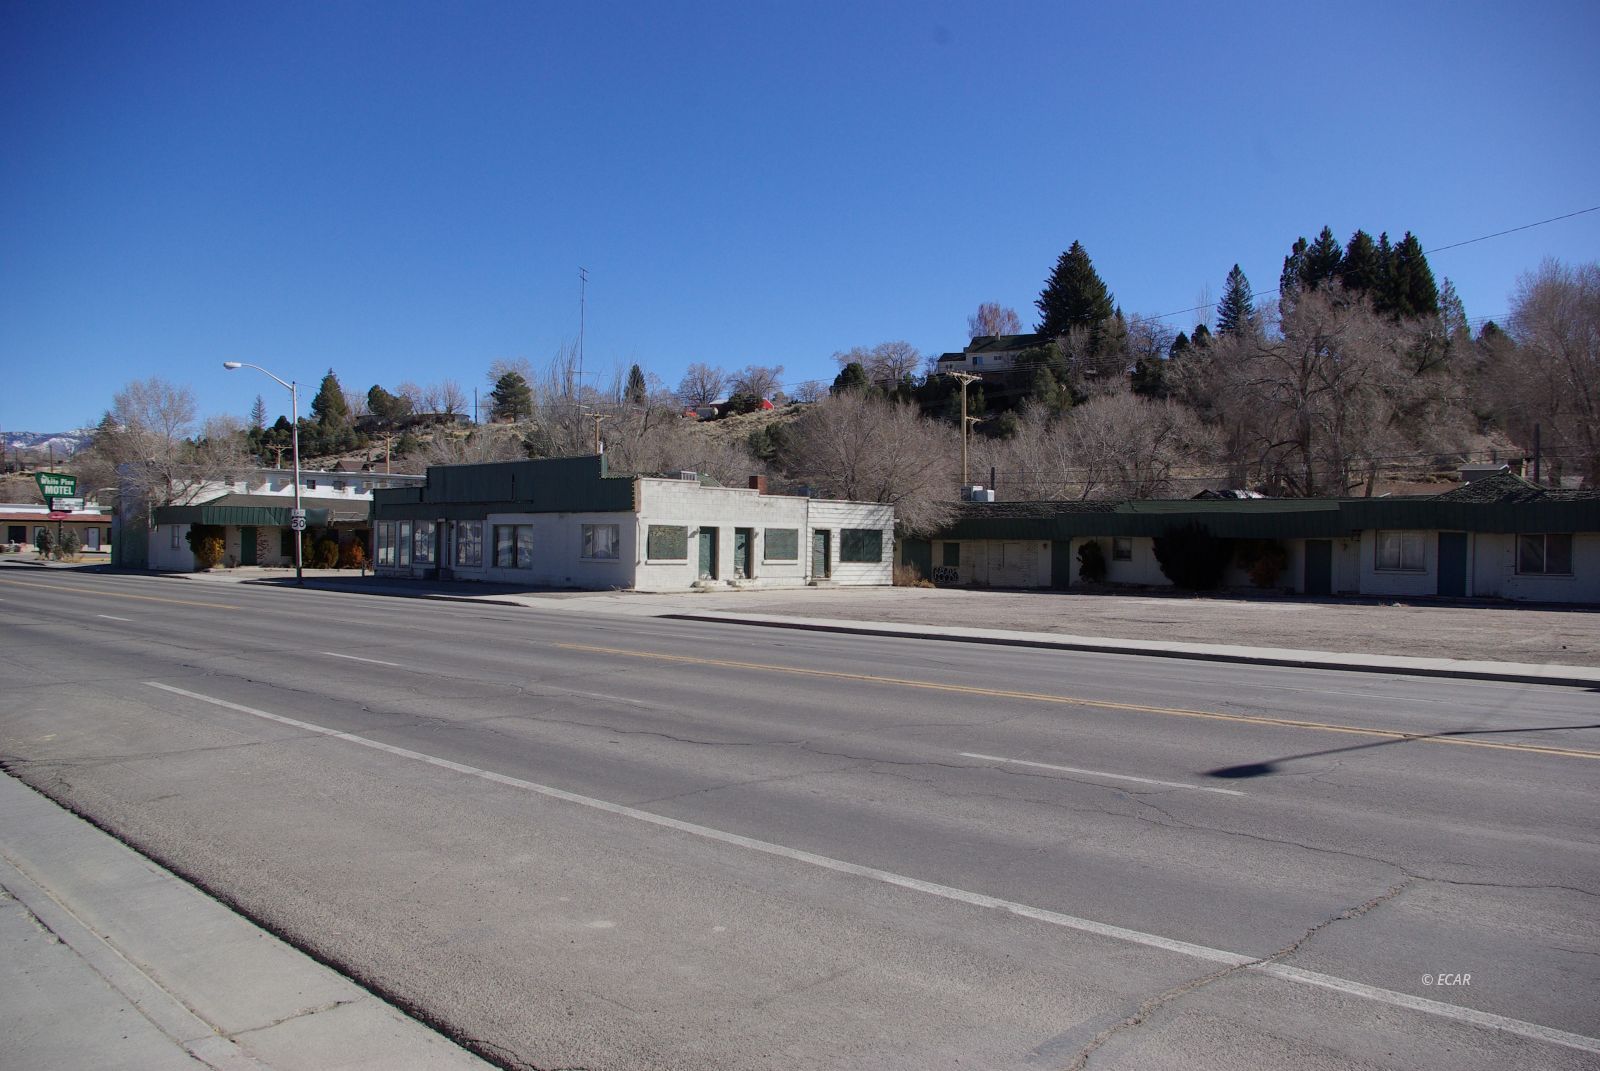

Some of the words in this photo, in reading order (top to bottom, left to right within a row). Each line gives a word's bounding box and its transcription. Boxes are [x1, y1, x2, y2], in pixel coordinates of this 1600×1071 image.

[41, 477, 59, 485] White
[60, 478, 75, 486] Pine
[44, 485, 73, 495] MOTEL
[292, 520, 304, 528] 50
